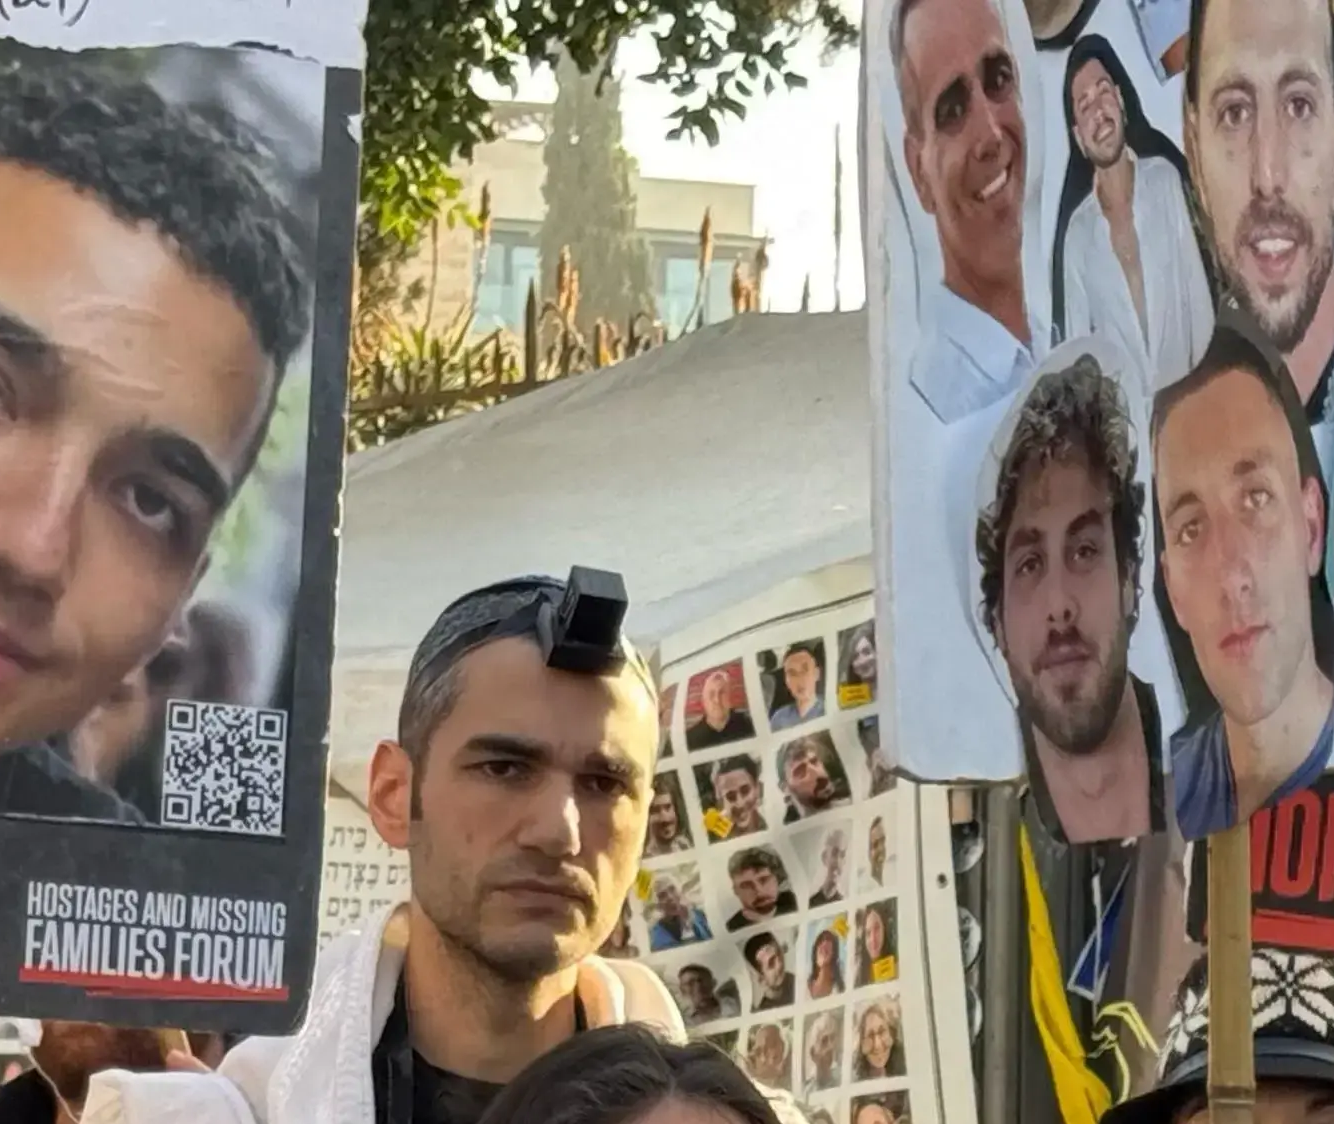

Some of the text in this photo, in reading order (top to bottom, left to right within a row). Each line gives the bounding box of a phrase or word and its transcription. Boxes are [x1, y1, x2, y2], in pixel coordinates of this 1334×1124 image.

[27, 880, 287, 937] HOSTAGES AND MISSING
[24, 918, 285, 990] FAMILIES FORUM
